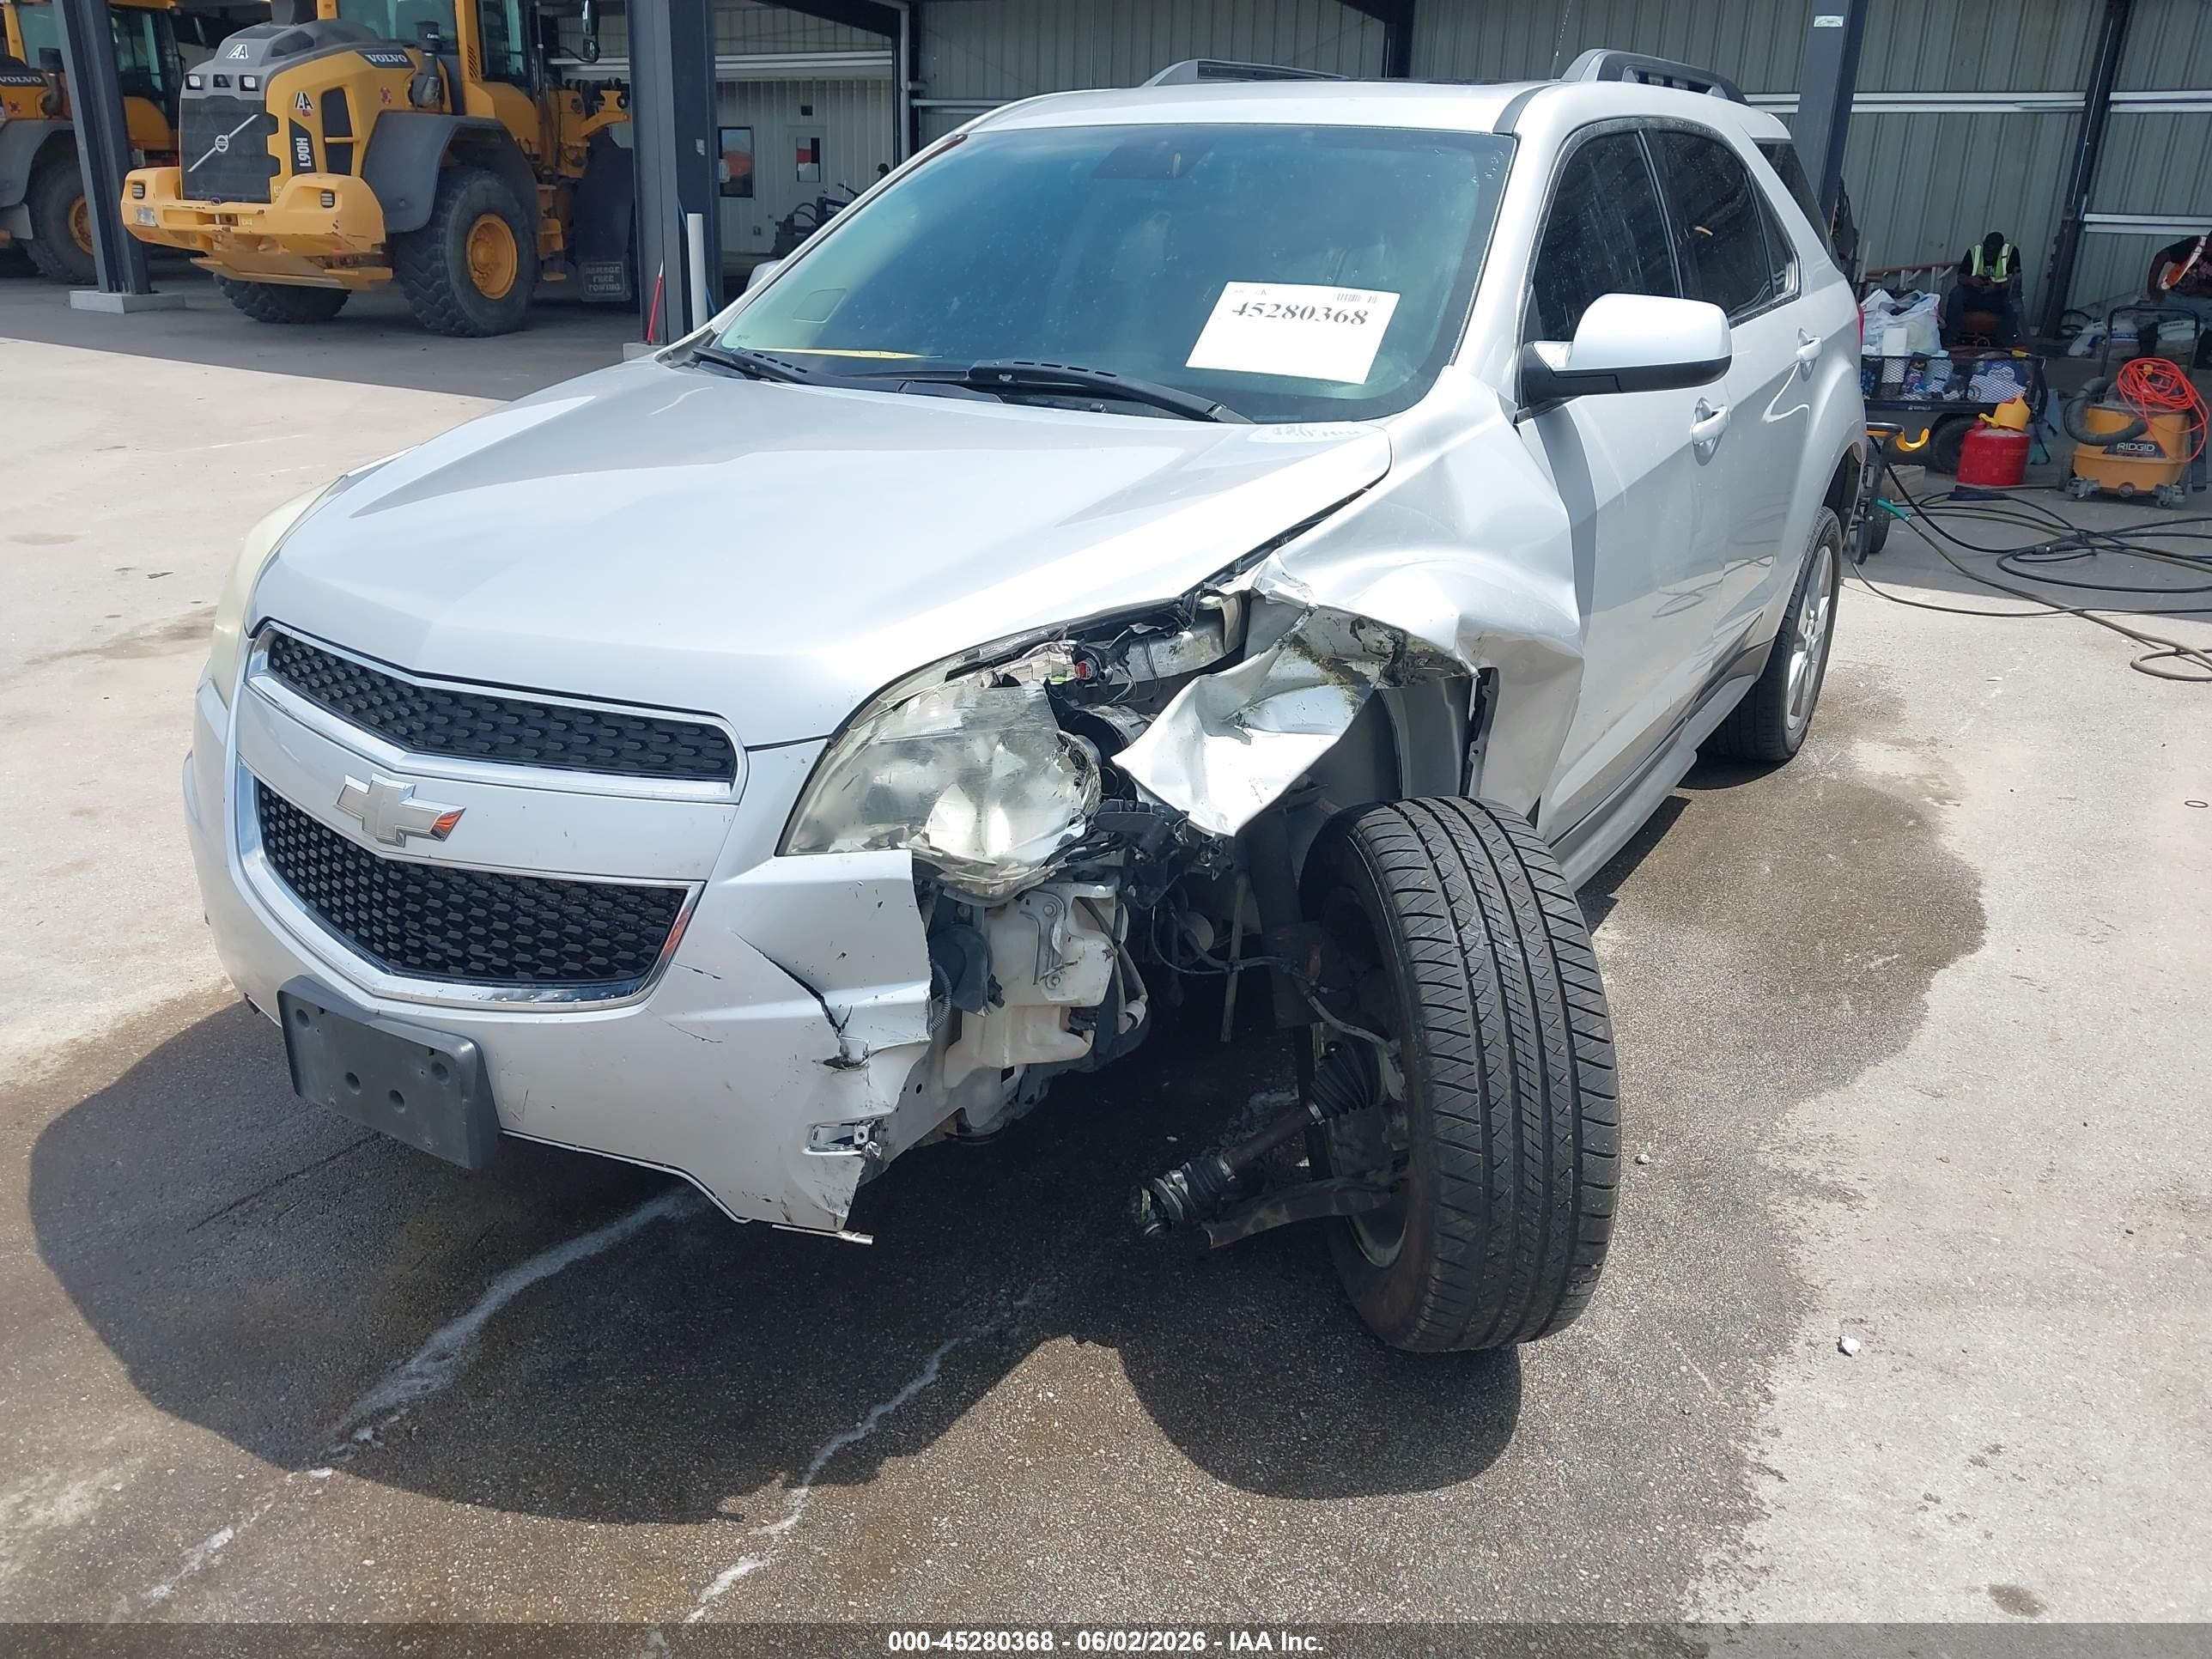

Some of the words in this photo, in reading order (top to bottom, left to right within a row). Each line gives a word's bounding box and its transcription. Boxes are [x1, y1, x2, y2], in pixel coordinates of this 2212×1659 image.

[364, 53, 408, 63] VOLVO
[295, 137, 313, 167] L90H
[1231, 301, 1369, 325] 45280368
[2117, 442, 2155, 452] RIDGID
